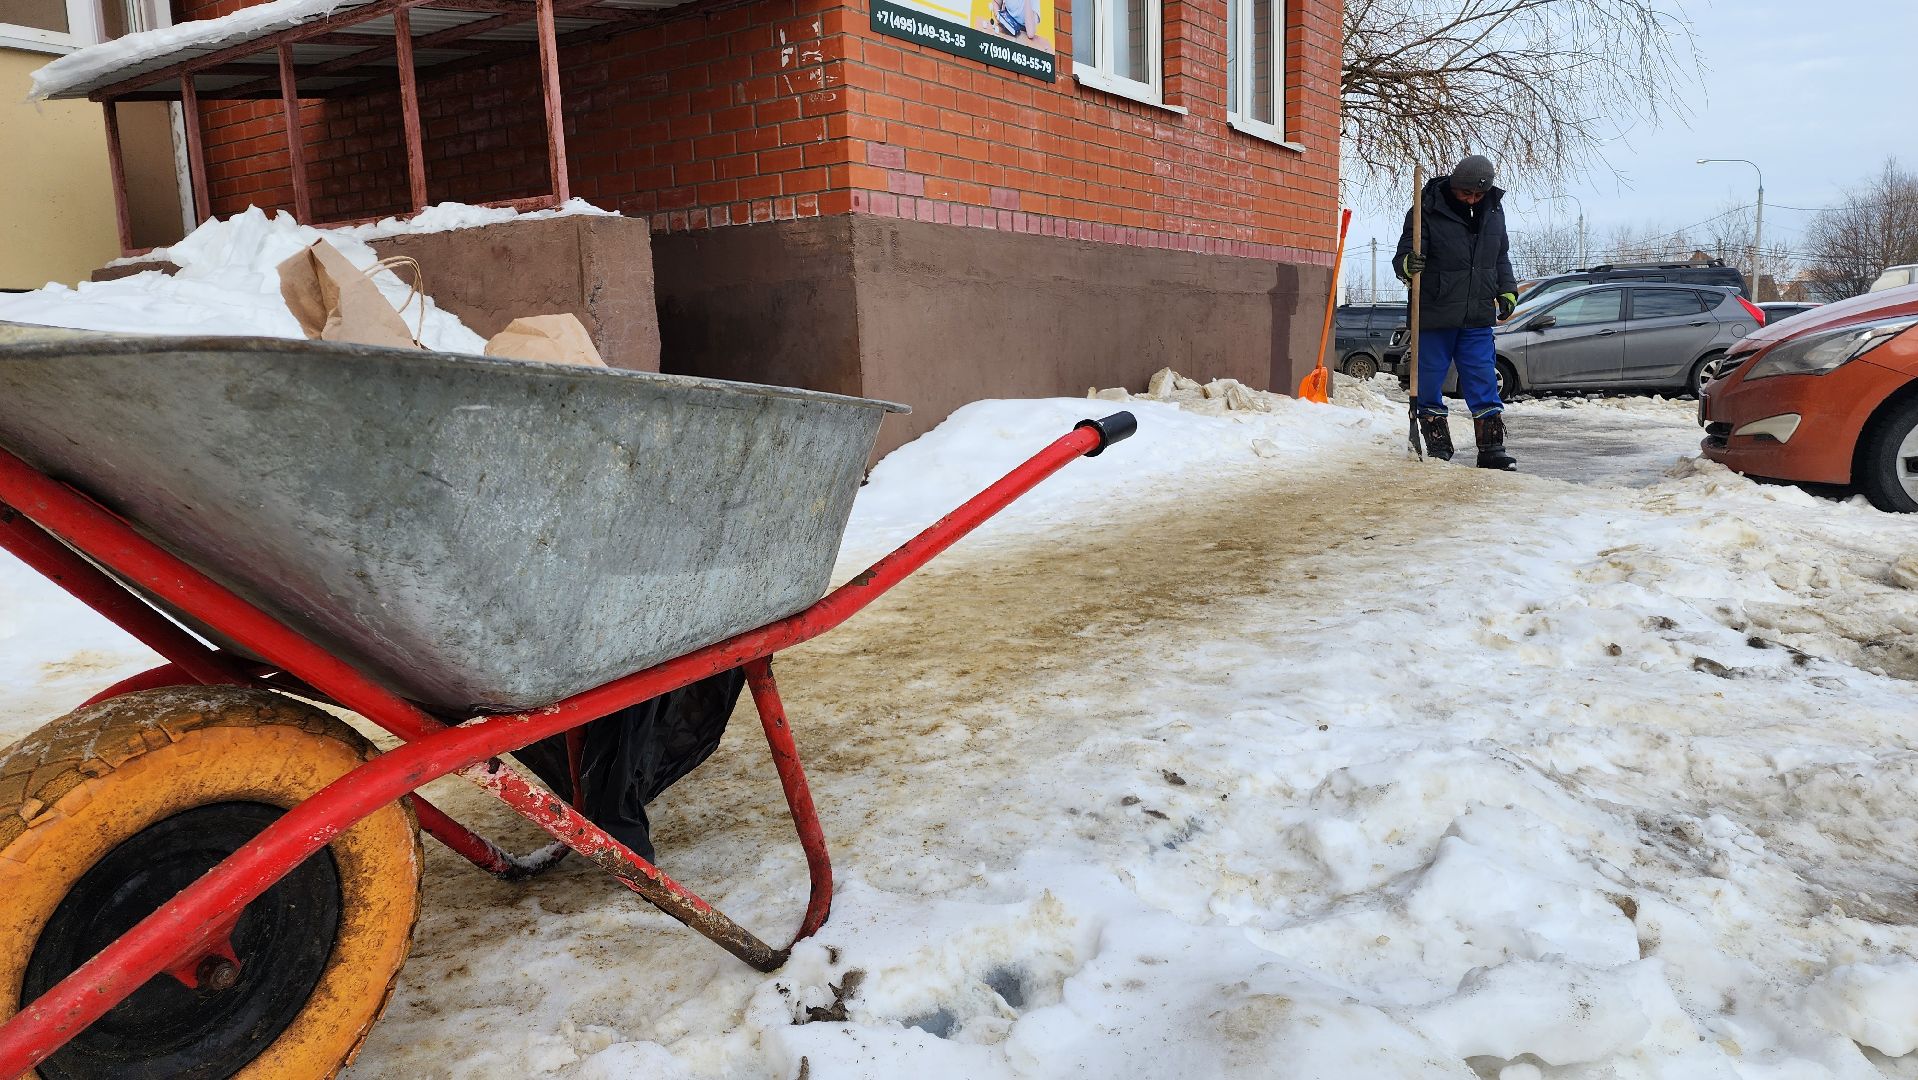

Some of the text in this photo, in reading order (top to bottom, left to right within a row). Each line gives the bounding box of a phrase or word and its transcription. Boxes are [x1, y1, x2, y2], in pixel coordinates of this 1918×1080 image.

[876, 10, 966, 48] +7 (495) 149-33-35
[979, 42, 1052, 74] +7 (910) 463-55-79
